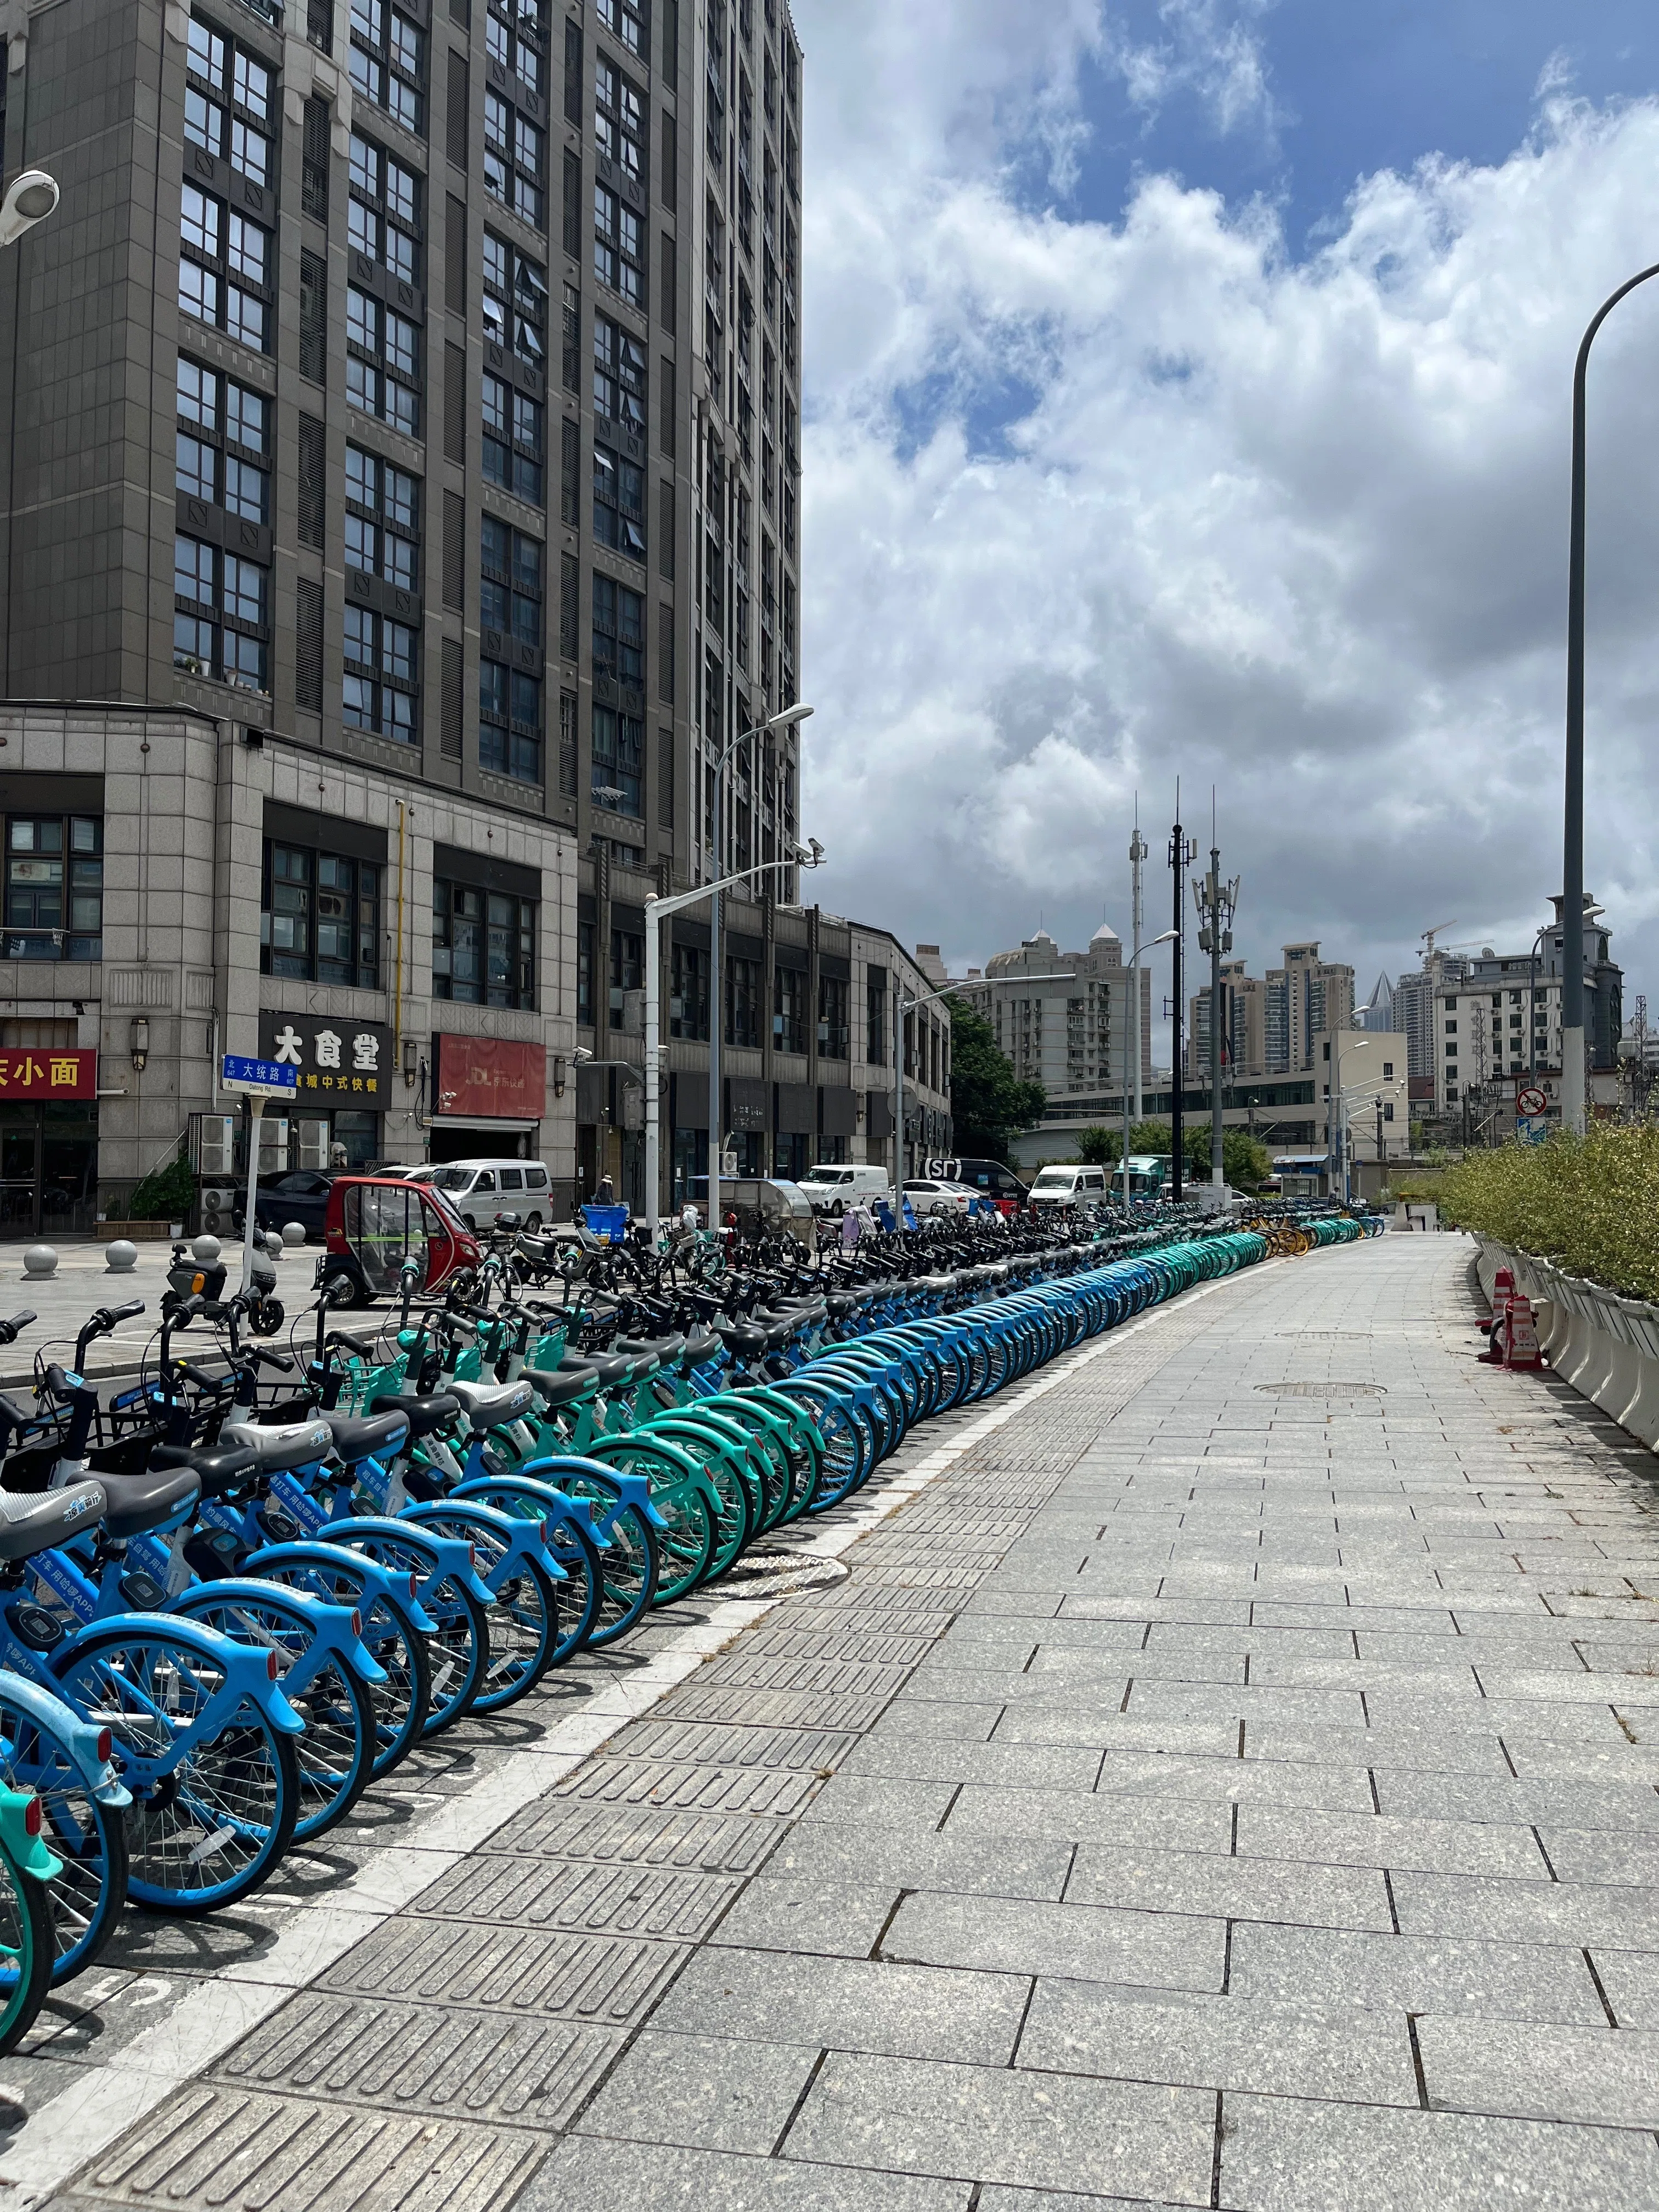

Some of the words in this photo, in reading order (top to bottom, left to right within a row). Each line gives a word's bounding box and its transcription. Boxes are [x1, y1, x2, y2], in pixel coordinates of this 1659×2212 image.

[274, 1025, 379, 1070] 大食堂
[228, 1059, 234, 1068] 北
[243, 1063, 279, 1081] 大统路
[287, 1069, 293, 1077] 南
[465, 1067, 492, 1085] JDL
[249, 1084, 263, 1092] Datong
[68, 1493, 99, 1520] 凉爽骑行
